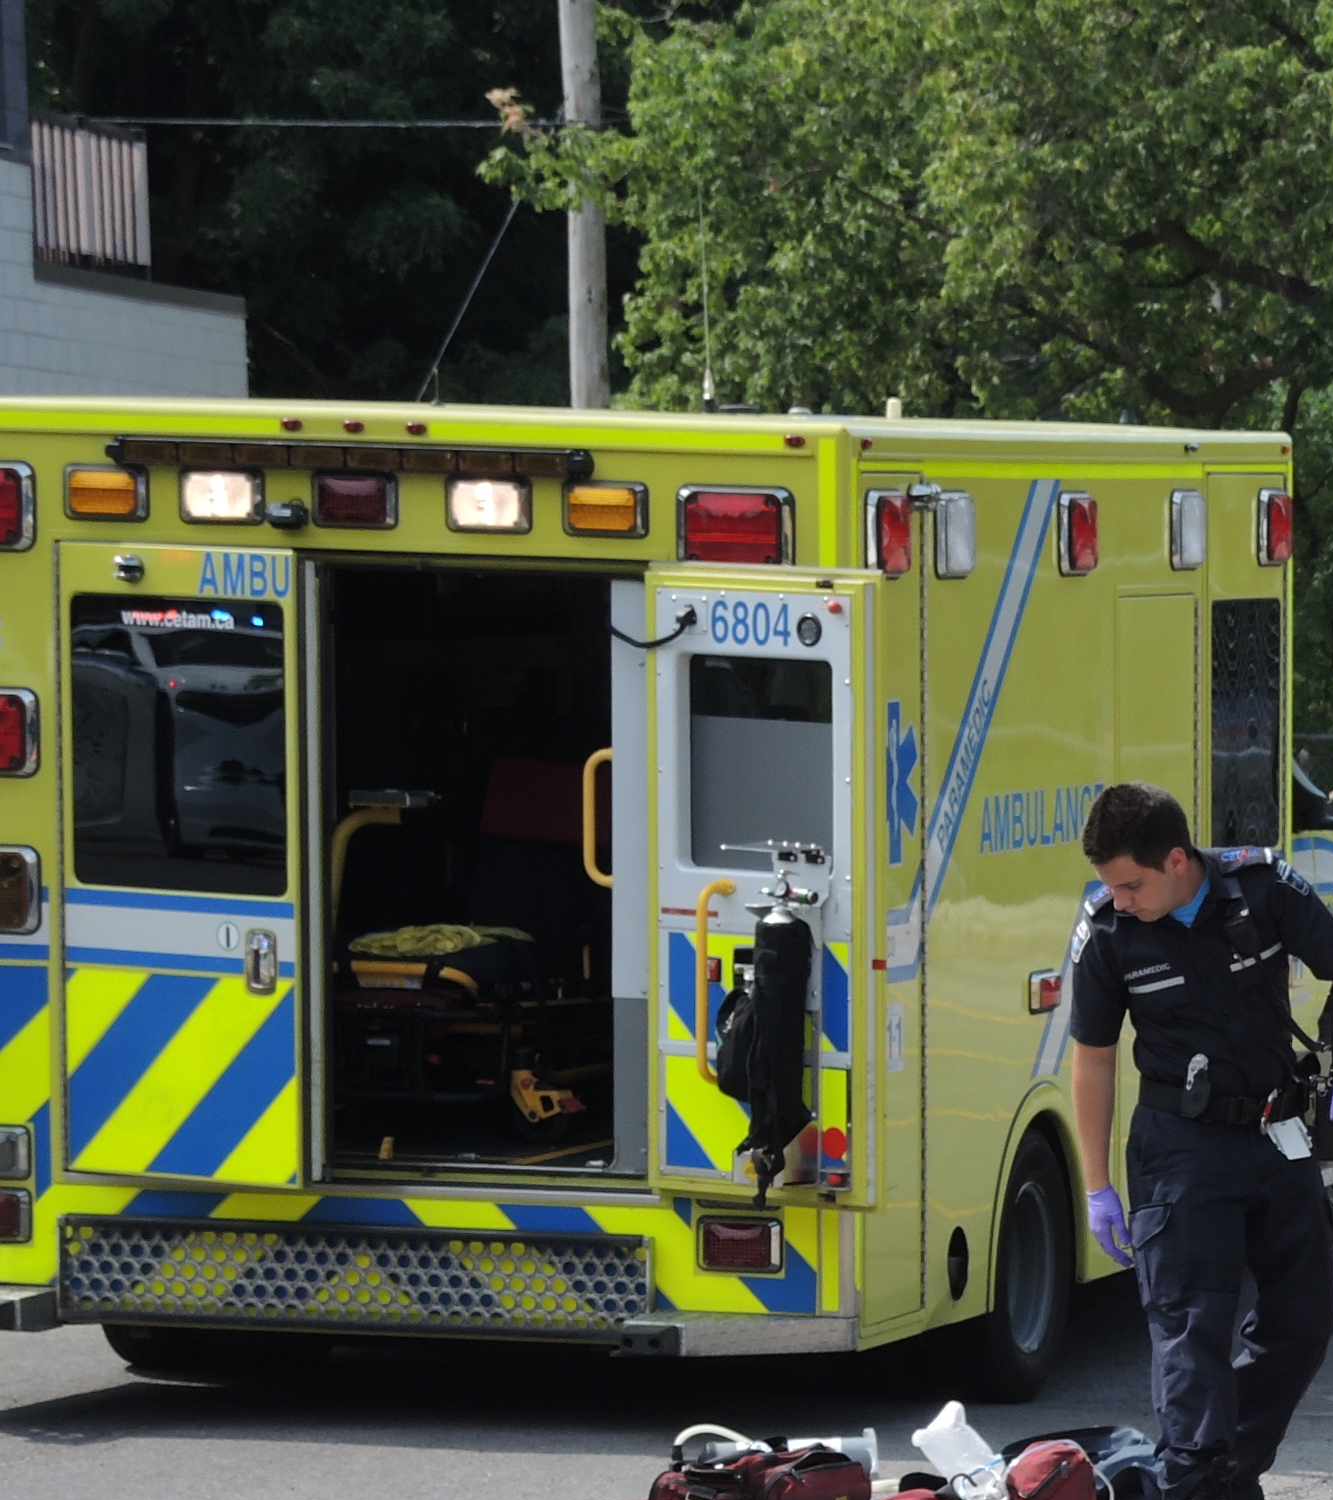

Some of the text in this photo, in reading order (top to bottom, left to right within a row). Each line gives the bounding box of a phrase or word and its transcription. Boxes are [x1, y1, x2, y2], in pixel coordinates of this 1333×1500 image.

[198, 550, 292, 598] AMBU
[120, 609, 235, 630] www.cetam.ca
[711, 600, 791, 647] 6804
[936, 678, 992, 854] PARAMEDIC
[979, 782, 1105, 856] AMBULANC
[1124, 963, 1171, 981] PARAMEDIC
